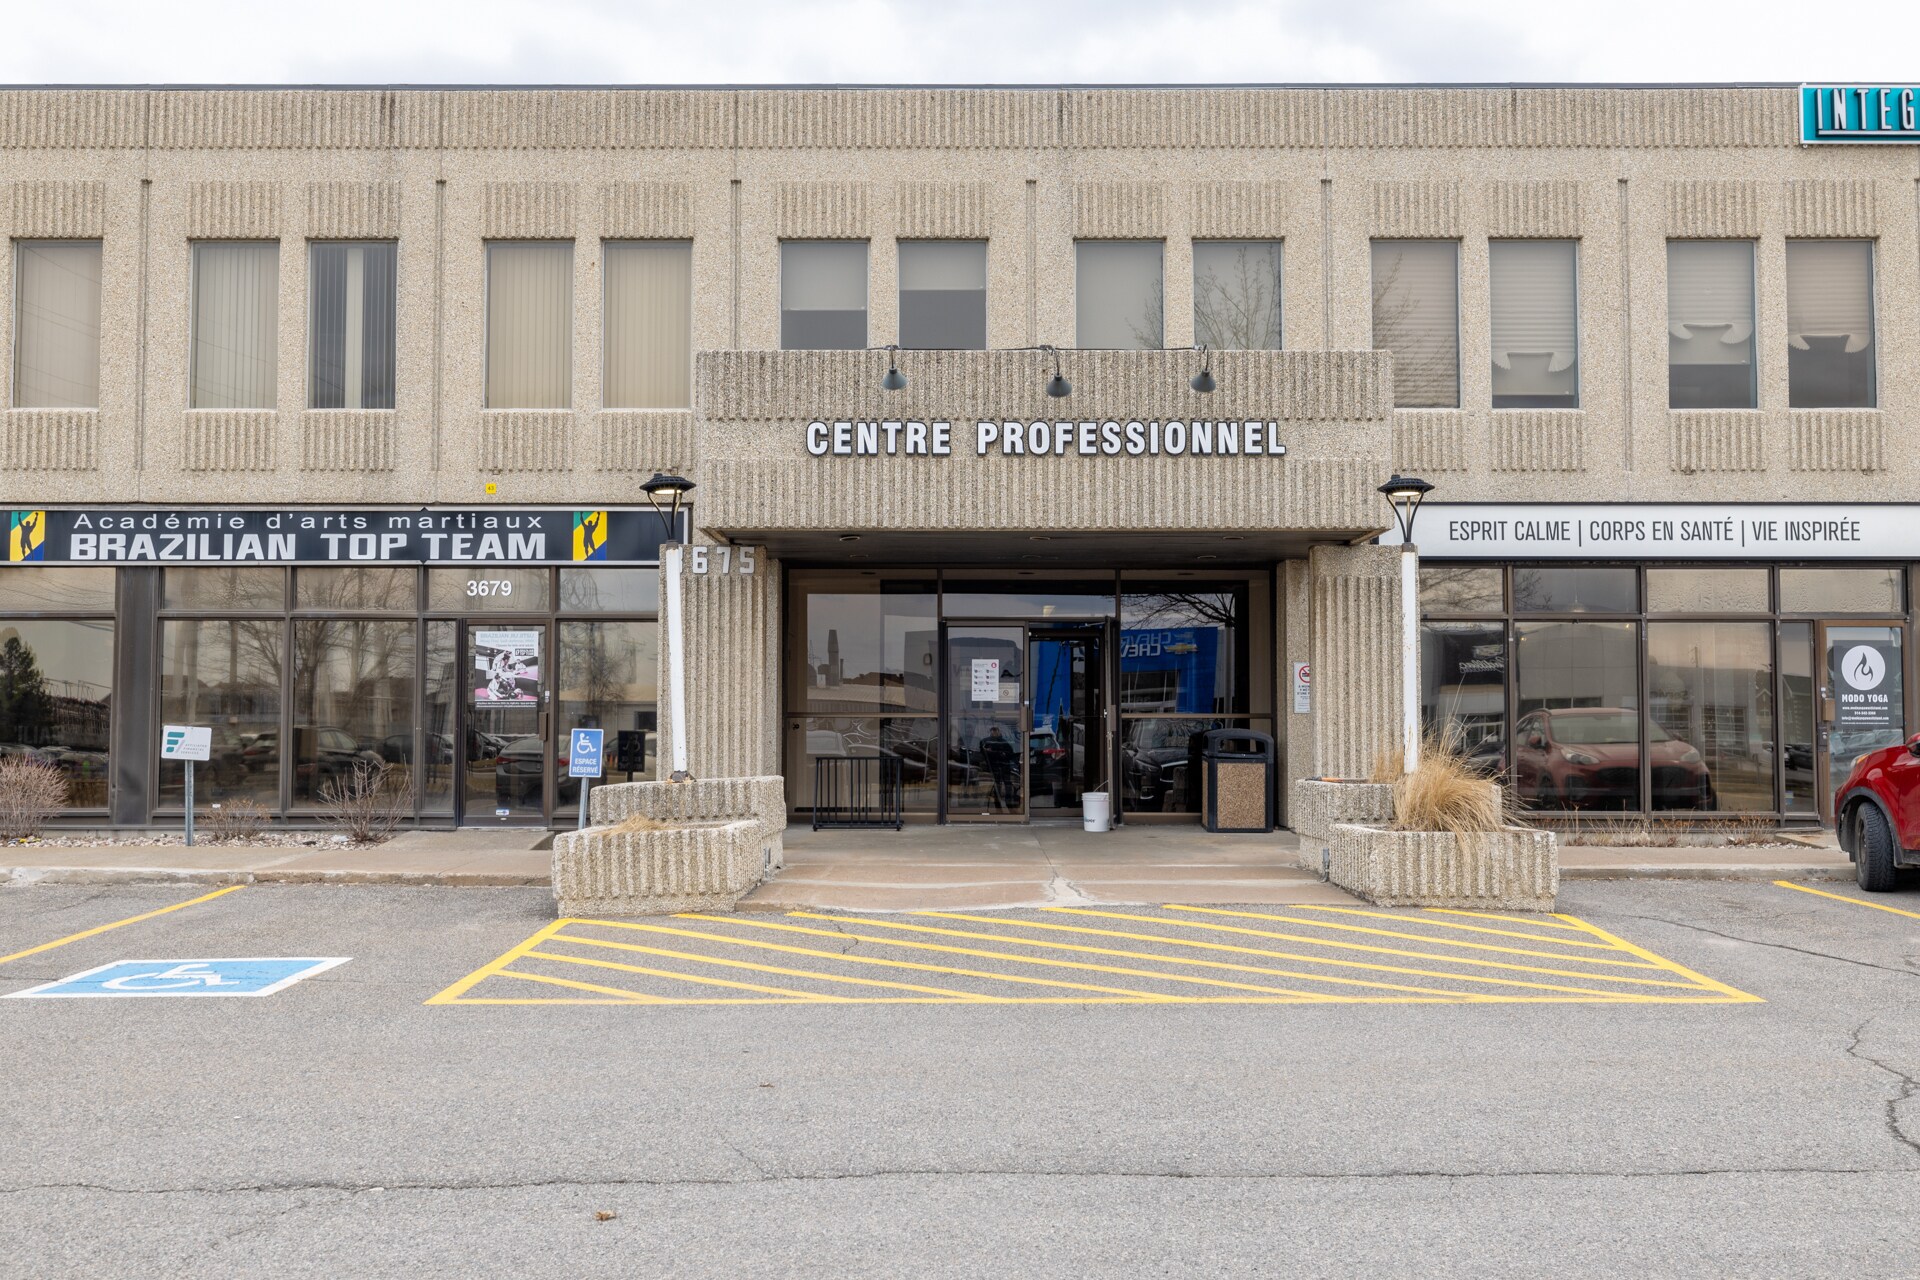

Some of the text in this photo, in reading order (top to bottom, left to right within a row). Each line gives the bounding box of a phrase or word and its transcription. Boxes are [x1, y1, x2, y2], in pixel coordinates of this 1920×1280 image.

[1815, 88, 1916, 131] INTEG
[806, 420, 1287, 456] CENTRE PROFESSIONNEL
[73, 513, 245, 529] Académie
[388, 513, 542, 528] martiaux
[1449, 516, 1861, 541] ESPRIT CALME CORPS EN SANTÉ VIE INSPIRÉE
[70, 533, 546, 560] BRAZILIAN TOP TEAM
[679, 546, 755, 574] 675
[466, 580, 513, 597] 3679
[1842, 694, 1888, 702] MODO YOGA
[572, 765, 599, 774] RÉSERVÉ
[574, 757, 597, 765] ESPACE
